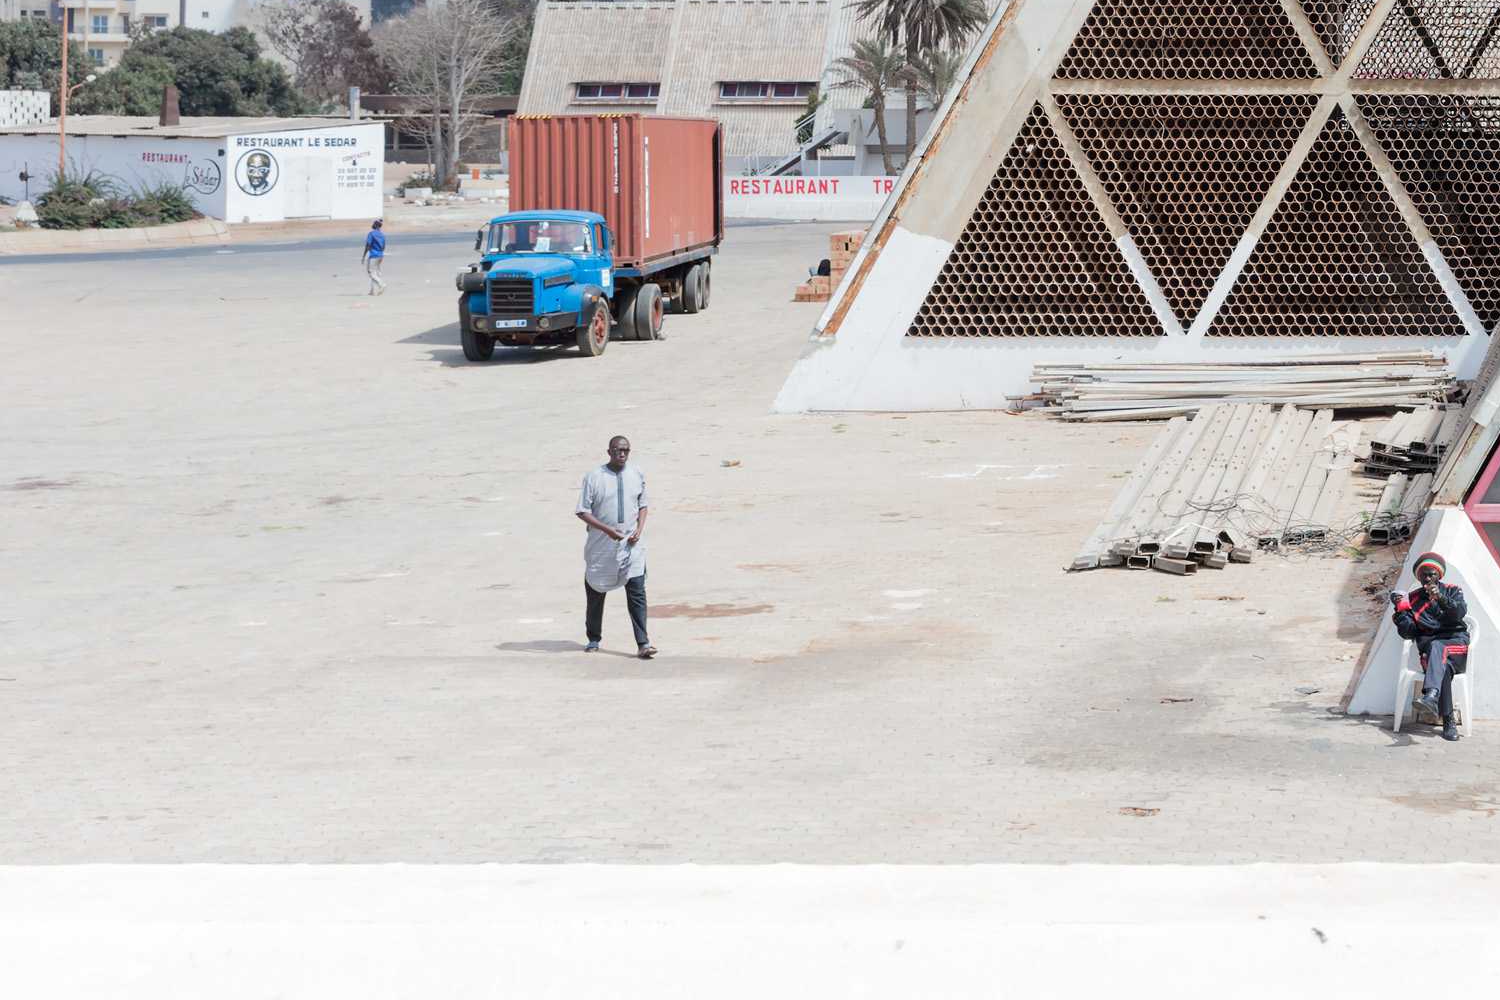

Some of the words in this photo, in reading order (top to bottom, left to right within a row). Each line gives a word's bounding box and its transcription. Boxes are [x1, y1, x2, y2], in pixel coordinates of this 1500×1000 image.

[236, 137, 304, 147] RESTAURANT
[308, 137, 321, 147] LE
[324, 137, 357, 147] SEDAR
[142, 152, 188, 164] RESTAURANT
[730, 179, 840, 195] RESTAURANT
[873, 179, 893, 195] TR
